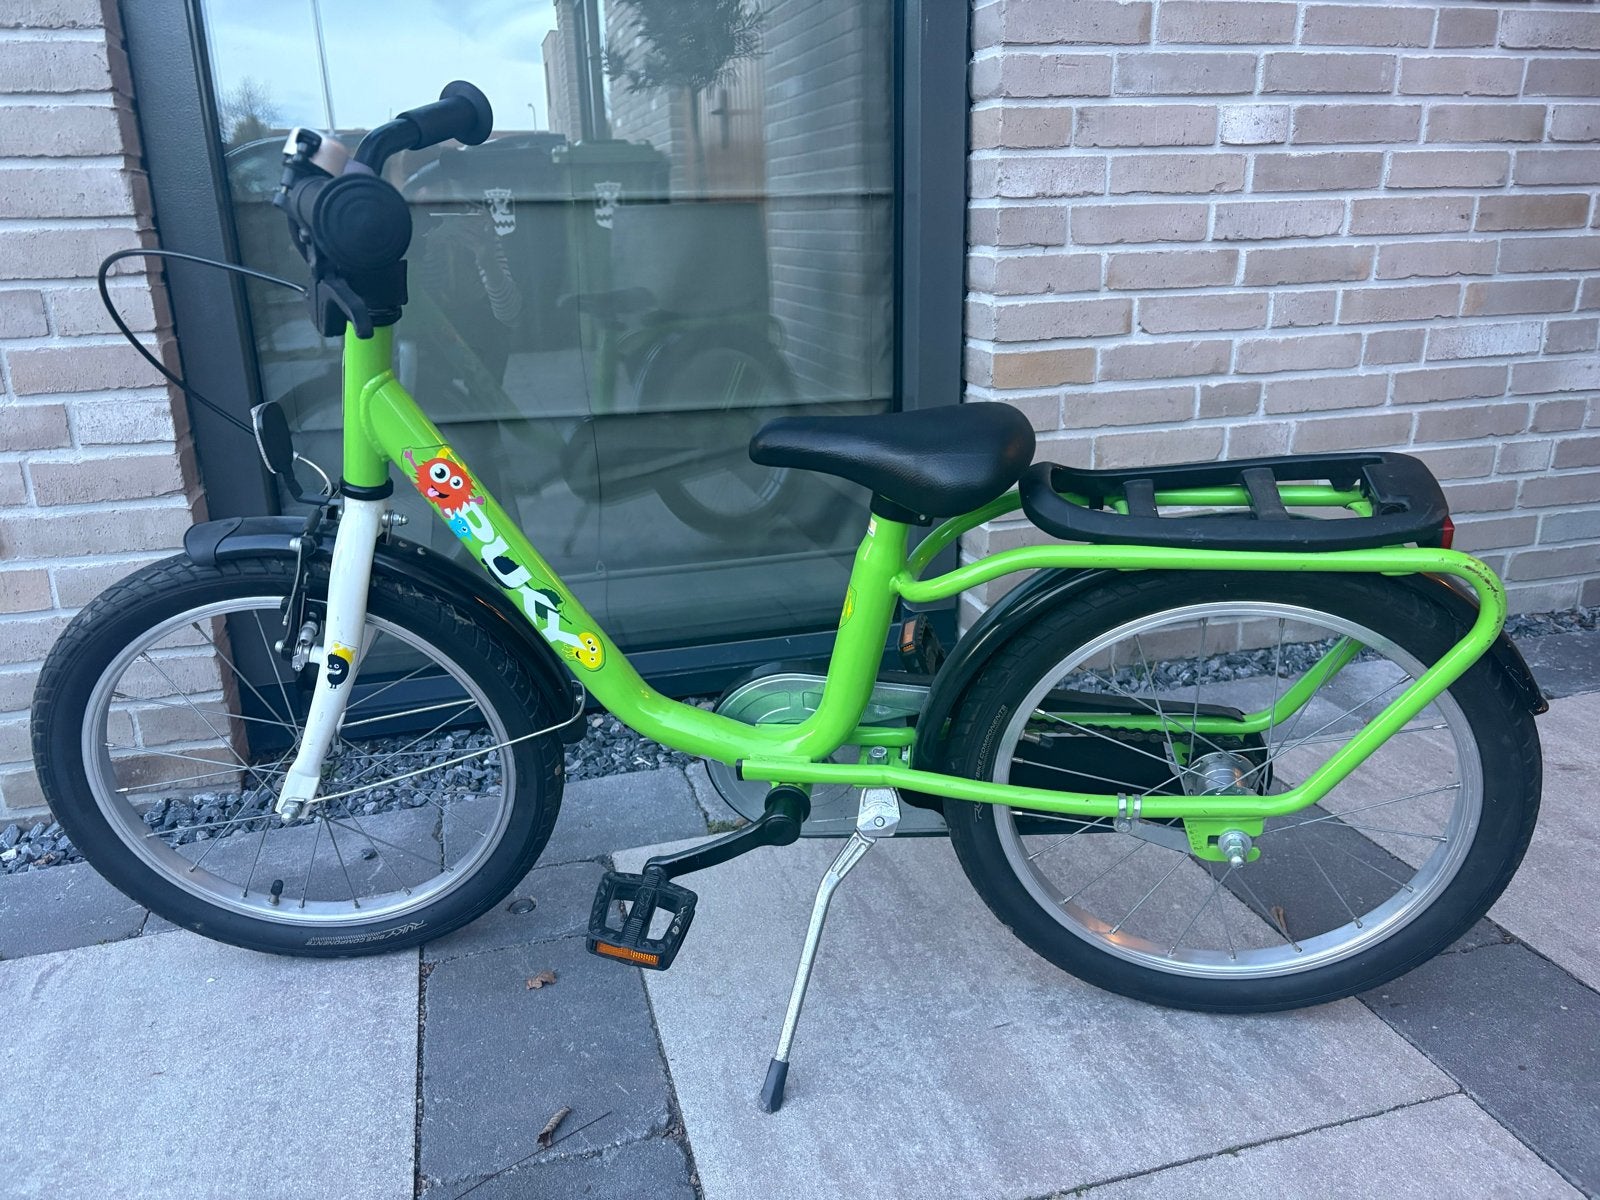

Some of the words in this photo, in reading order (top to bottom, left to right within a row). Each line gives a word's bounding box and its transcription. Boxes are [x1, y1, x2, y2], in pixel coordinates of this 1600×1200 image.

[446, 501, 587, 650] PUKY
[975, 758, 983, 778] BIKE
[366, 934, 385, 943] BIKE
